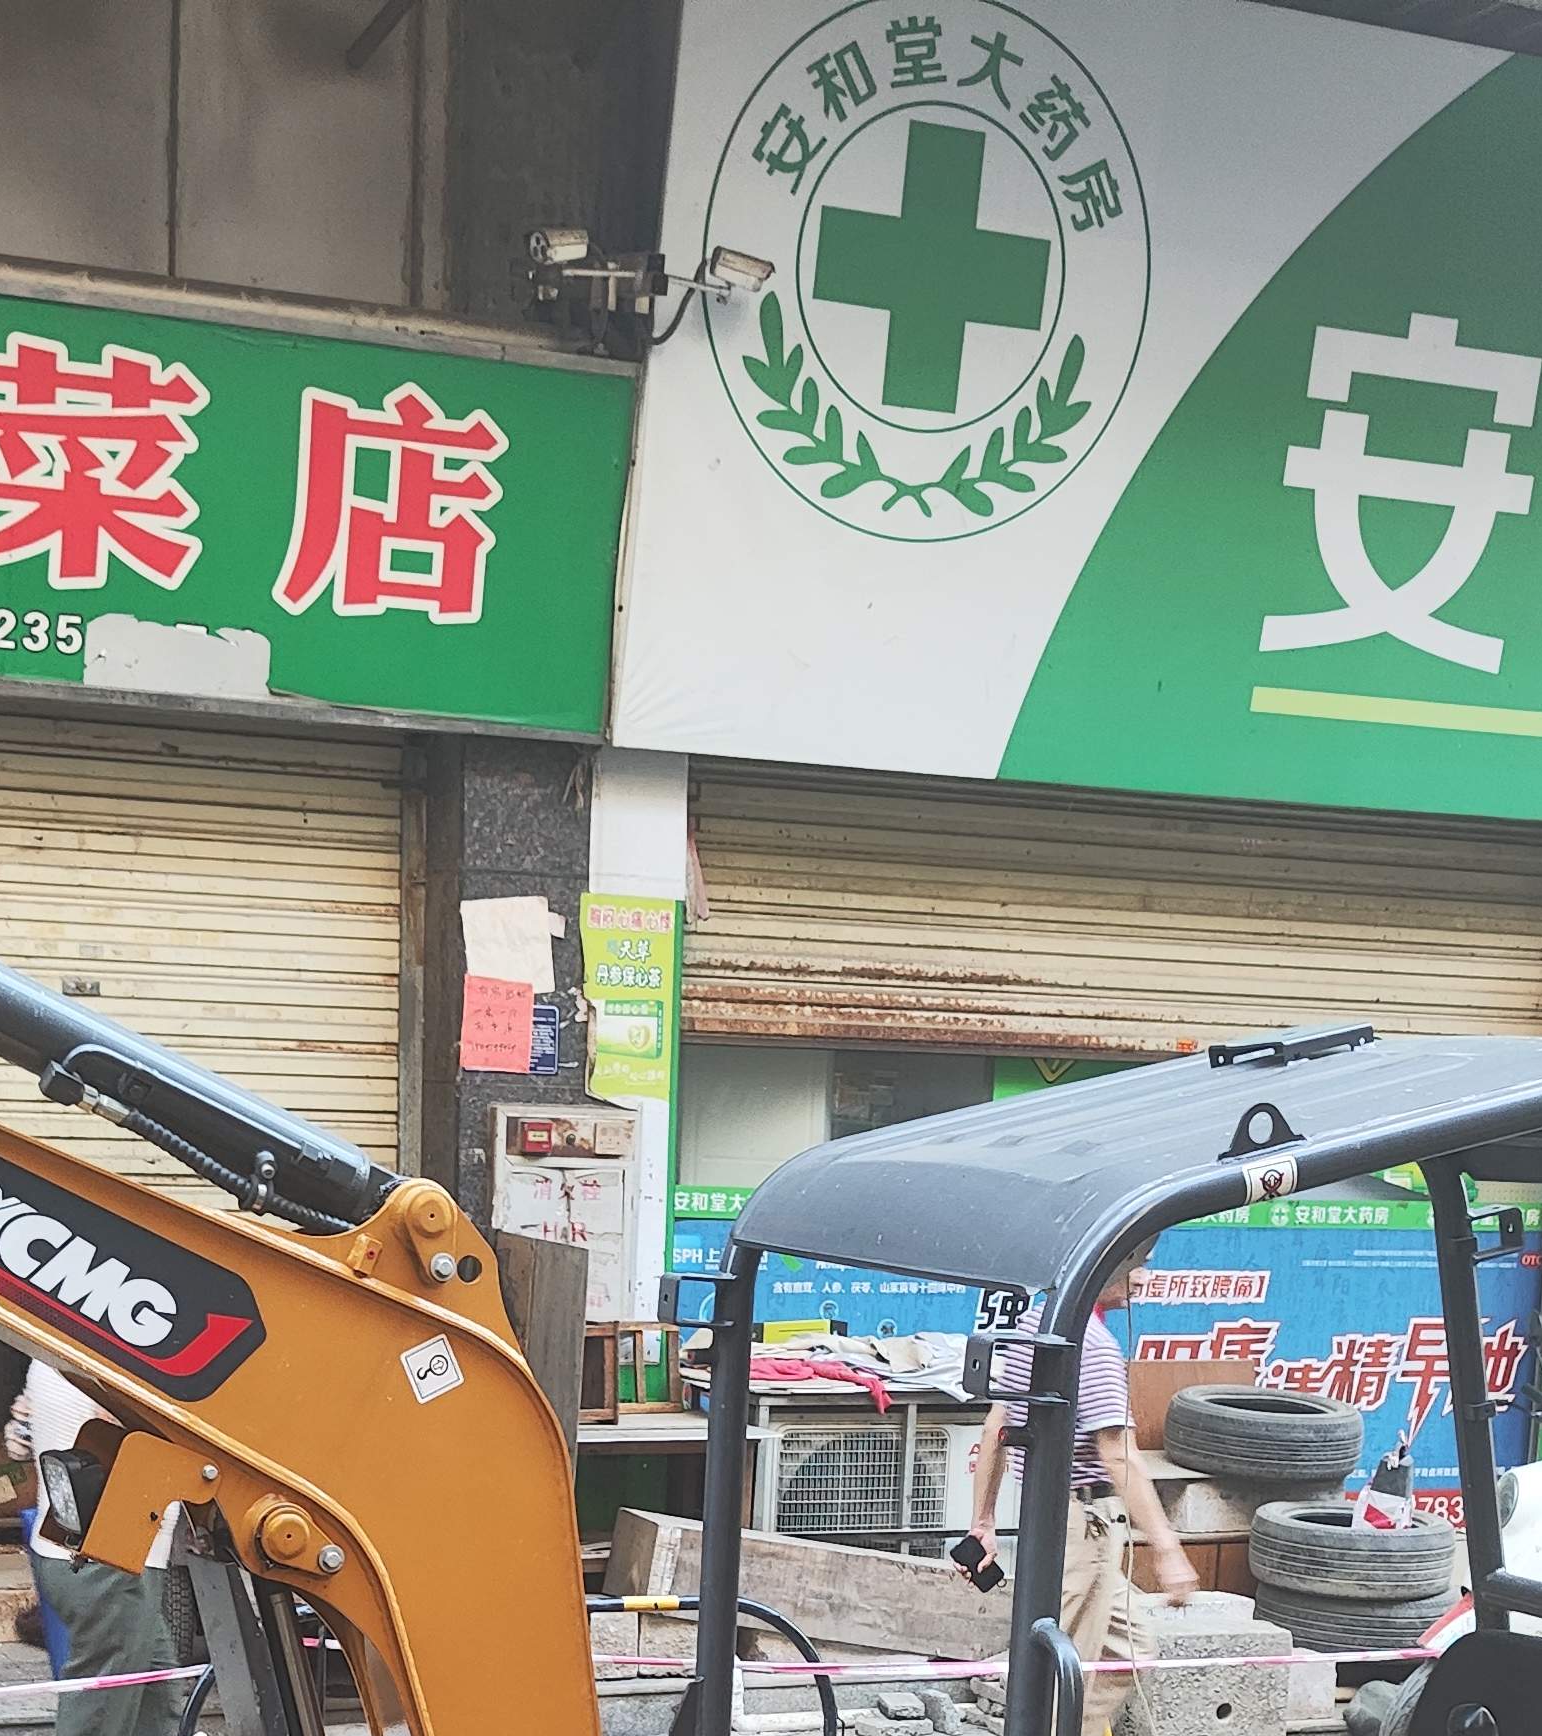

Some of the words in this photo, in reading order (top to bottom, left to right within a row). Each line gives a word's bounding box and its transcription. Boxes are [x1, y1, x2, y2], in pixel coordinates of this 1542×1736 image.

[750, 15, 1123, 233] 安和堂大药房
[1295, 1206, 1390, 1224] 安和堂大药房
[672, 1248, 703, 1264] SPH
[1412, 1495, 1465, 1525] 783
